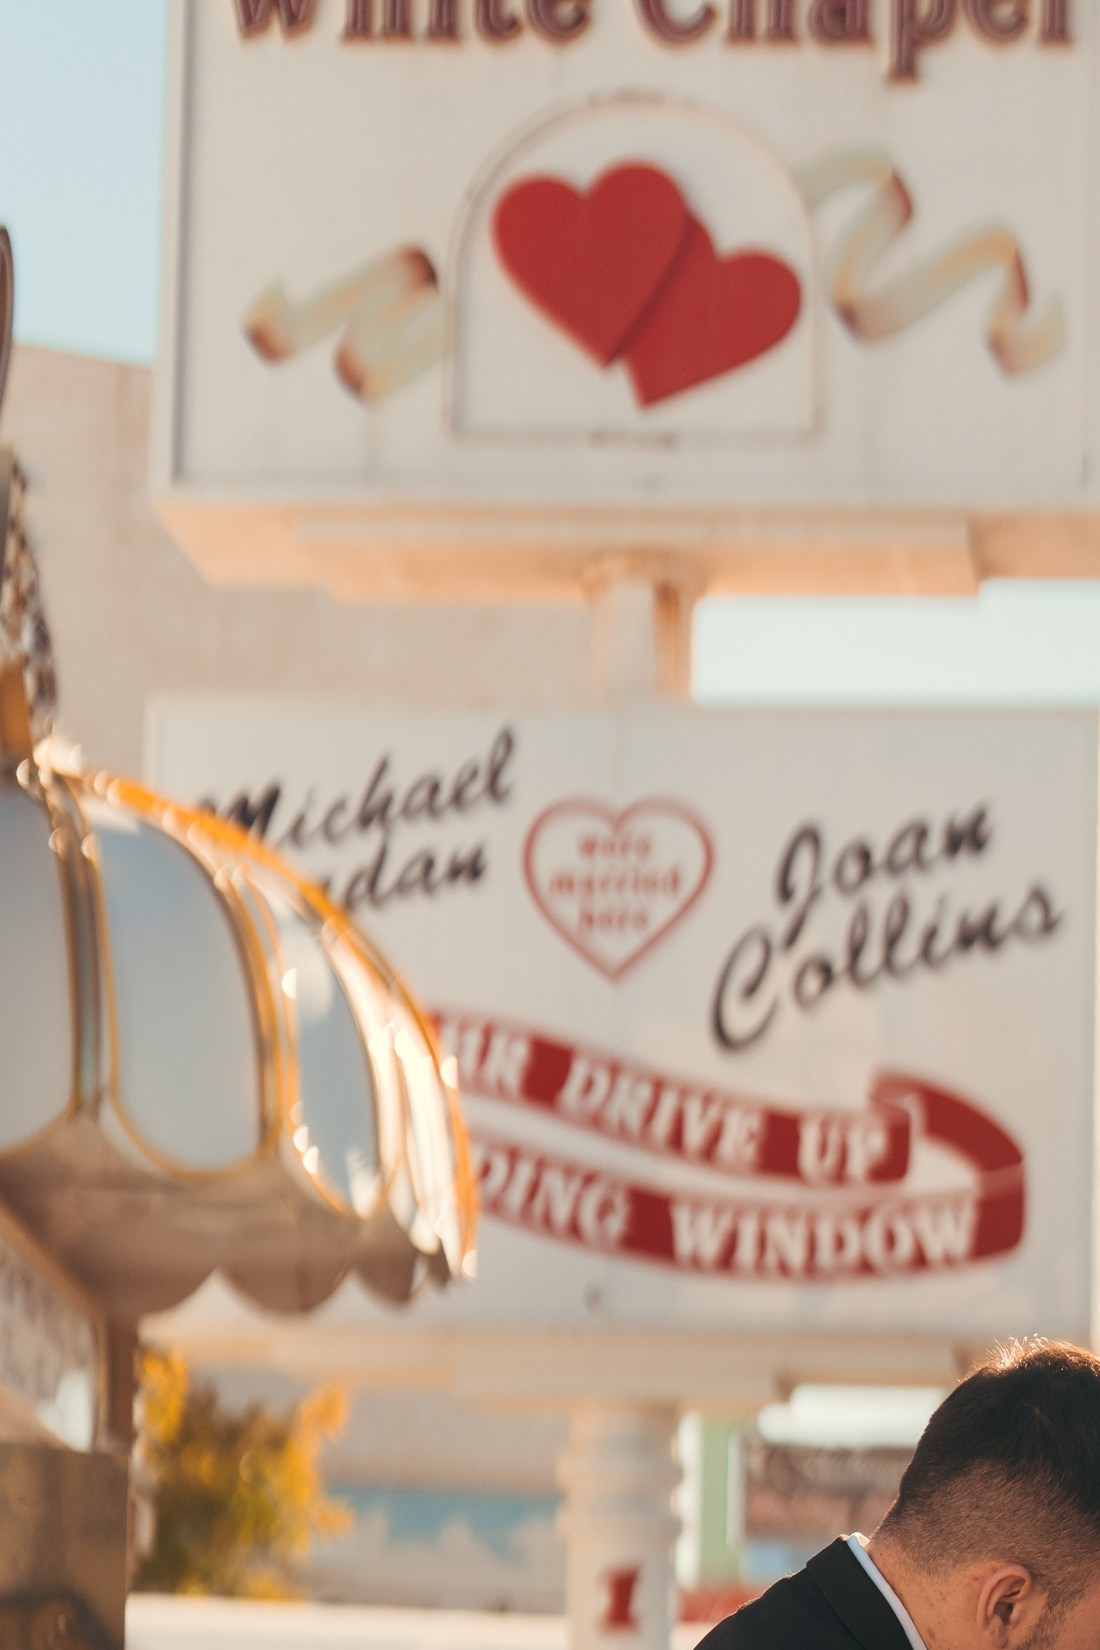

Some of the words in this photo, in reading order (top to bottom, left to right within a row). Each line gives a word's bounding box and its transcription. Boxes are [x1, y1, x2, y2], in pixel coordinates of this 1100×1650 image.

[198, 725, 514, 846] Michael
[552, 866, 680, 896] married
[774, 803, 992, 950] Joan
[709, 882, 1062, 1055] Collins
[558, 1054, 765, 1164] DRIVE
[800, 1112, 889, 1179] UP
[670, 1200, 976, 1272] WINDOW
